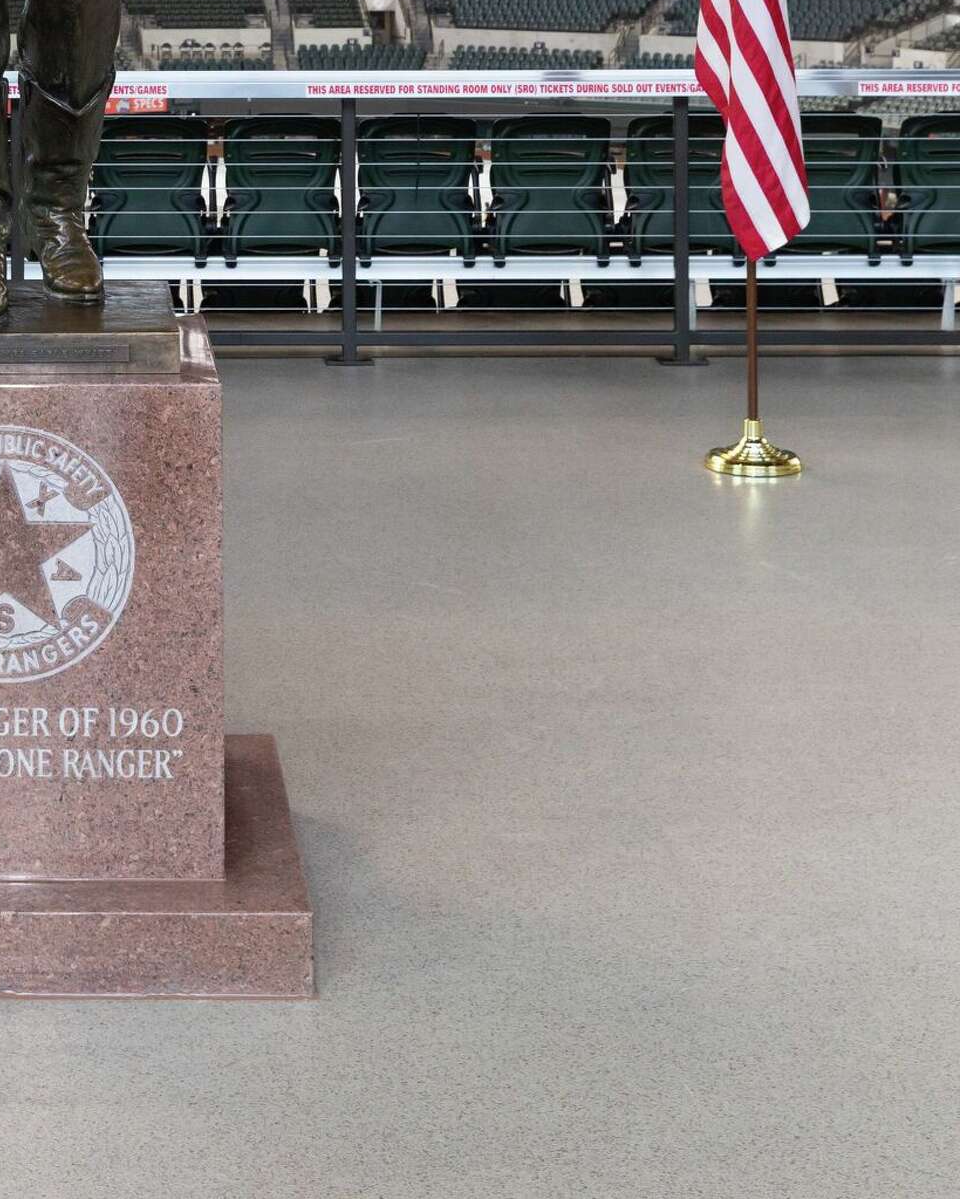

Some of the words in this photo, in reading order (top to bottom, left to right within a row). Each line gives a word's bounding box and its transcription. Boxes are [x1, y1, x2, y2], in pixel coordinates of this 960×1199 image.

[113, 85, 167, 95] ENTS/GAMES
[307, 85, 327, 95] THIS
[329, 85, 351, 95] AREA
[353, 85, 396, 95] RESERVED
[398, 85, 415, 94] FOR
[417, 84, 460, 94] STANDING
[463, 84, 489, 94] ROOM
[491, 84, 513, 94] ONLY
[514, 84, 538, 95] (SRO)
[540, 84, 574, 93] TICKETS
[577, 84, 609, 93] DURING
[611, 83, 633, 93] SOLD
[636, 83, 652, 93] OUT
[860, 83, 879, 92] THIS
[882, 83, 904, 92] AREA
[907, 83, 949, 92] RESERVED
[45, 446, 104, 496] SAFETY
[58, 707, 99, 738] OF
[108, 707, 184, 738] 1960
